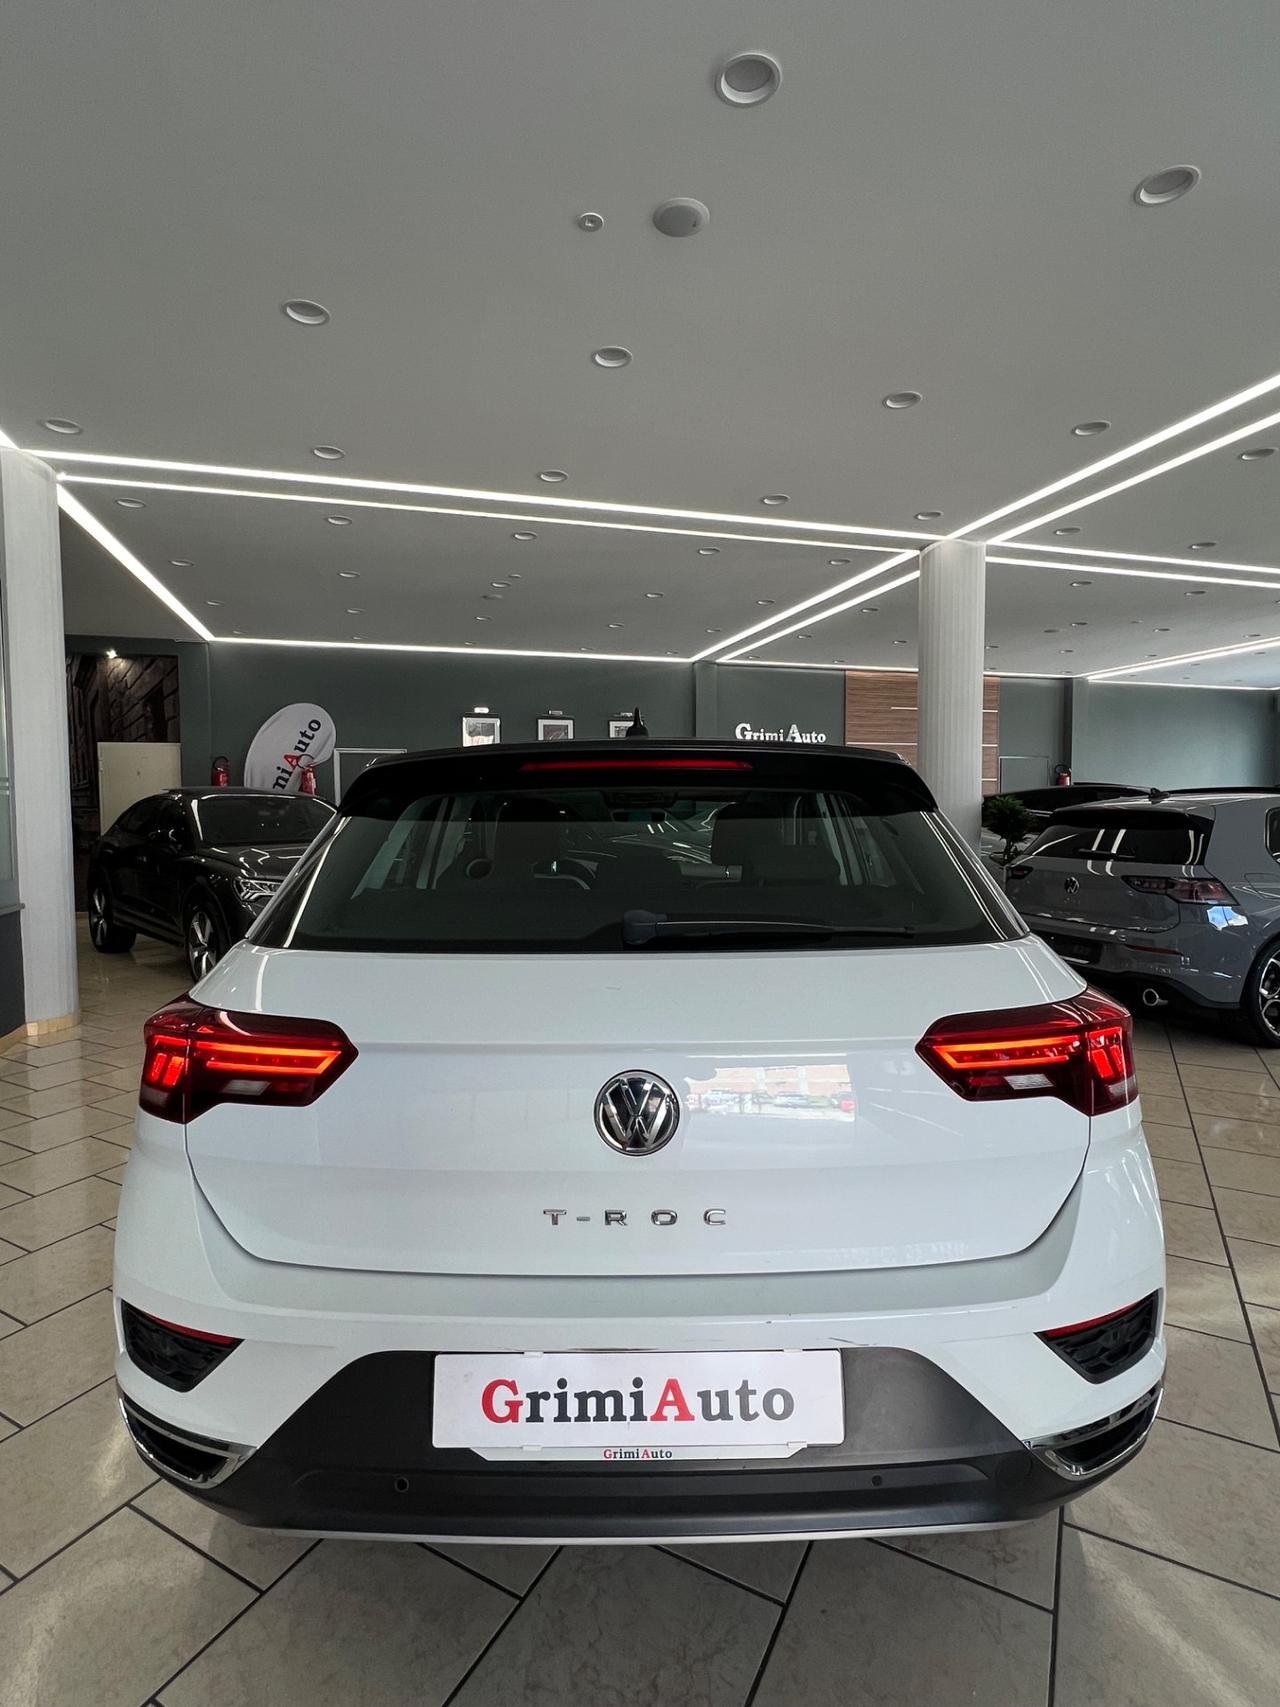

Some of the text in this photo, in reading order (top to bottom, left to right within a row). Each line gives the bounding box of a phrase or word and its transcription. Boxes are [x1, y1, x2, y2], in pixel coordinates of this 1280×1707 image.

[272, 719, 322, 790] miAuto
[543, 1208, 727, 1227] T-ROC
[481, 1376, 796, 1424] GrimiAuto
[603, 1447, 673, 1460] GrimiAuto
